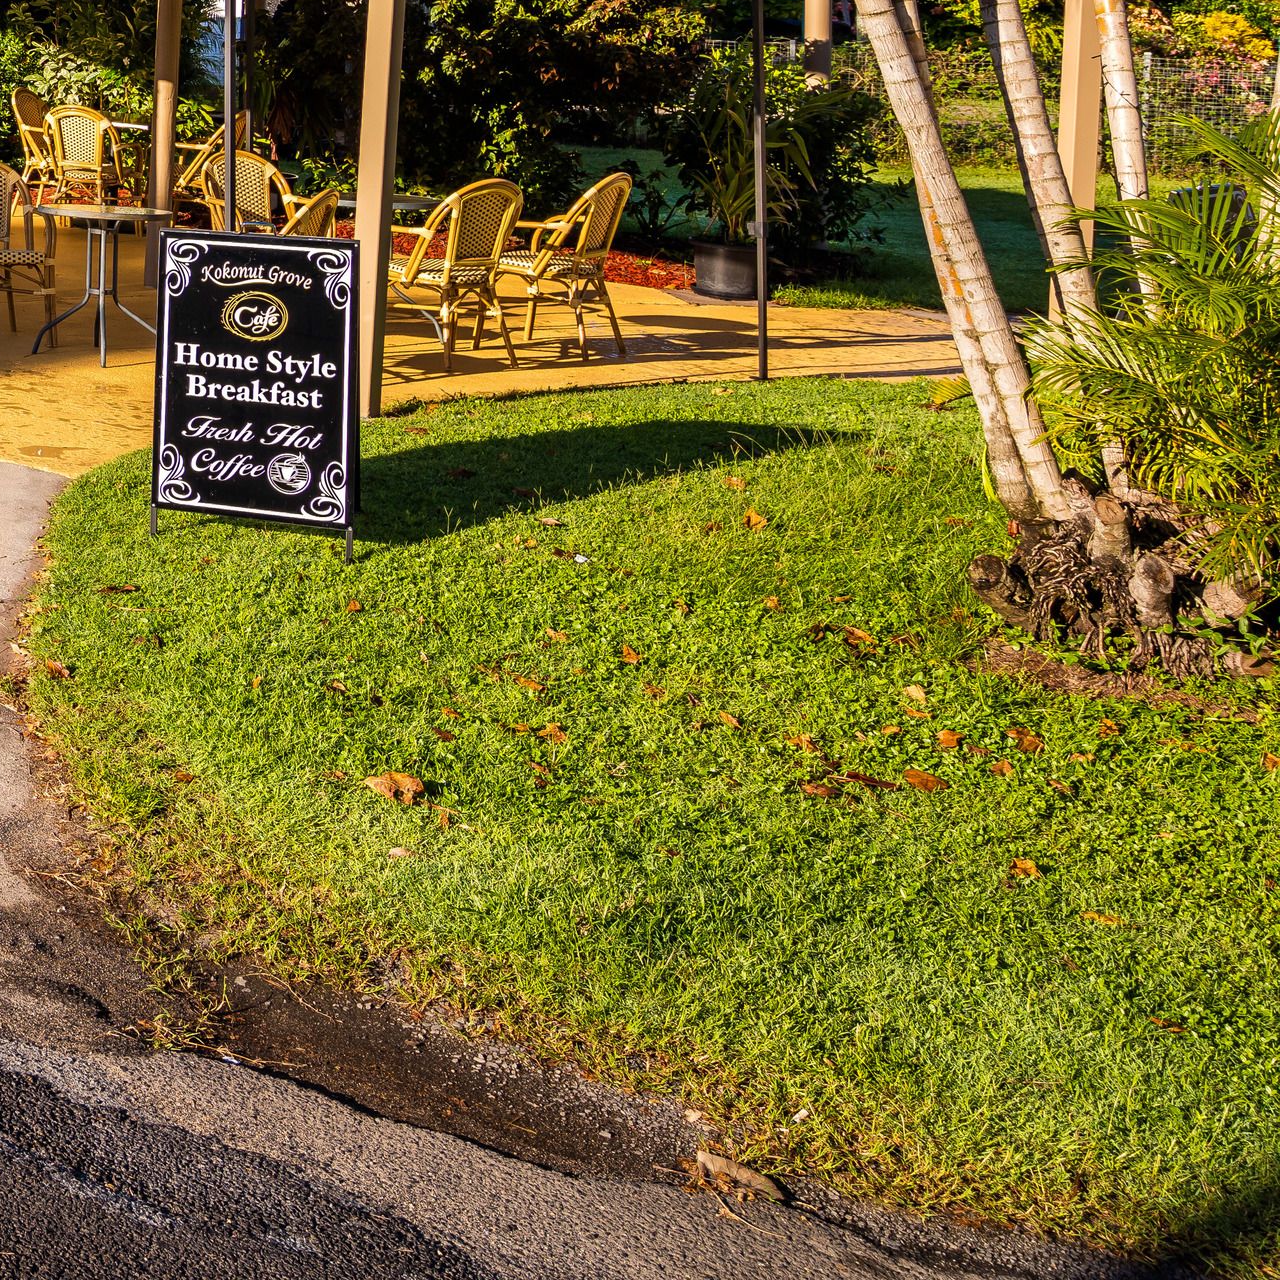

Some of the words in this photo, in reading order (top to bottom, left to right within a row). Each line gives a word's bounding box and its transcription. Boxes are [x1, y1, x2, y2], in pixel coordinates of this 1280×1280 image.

[201, 261, 265, 287] Kokonut
[268, 265, 313, 290] Grove
[234, 305, 281, 334] Café
[173, 341, 259, 371] Home
[265, 350, 337, 384] Style
[185, 373, 323, 409] Breakfast
[181, 415, 255, 443] Fresh
[259, 423, 324, 450] Hot
[190, 447, 266, 482] Coffee
